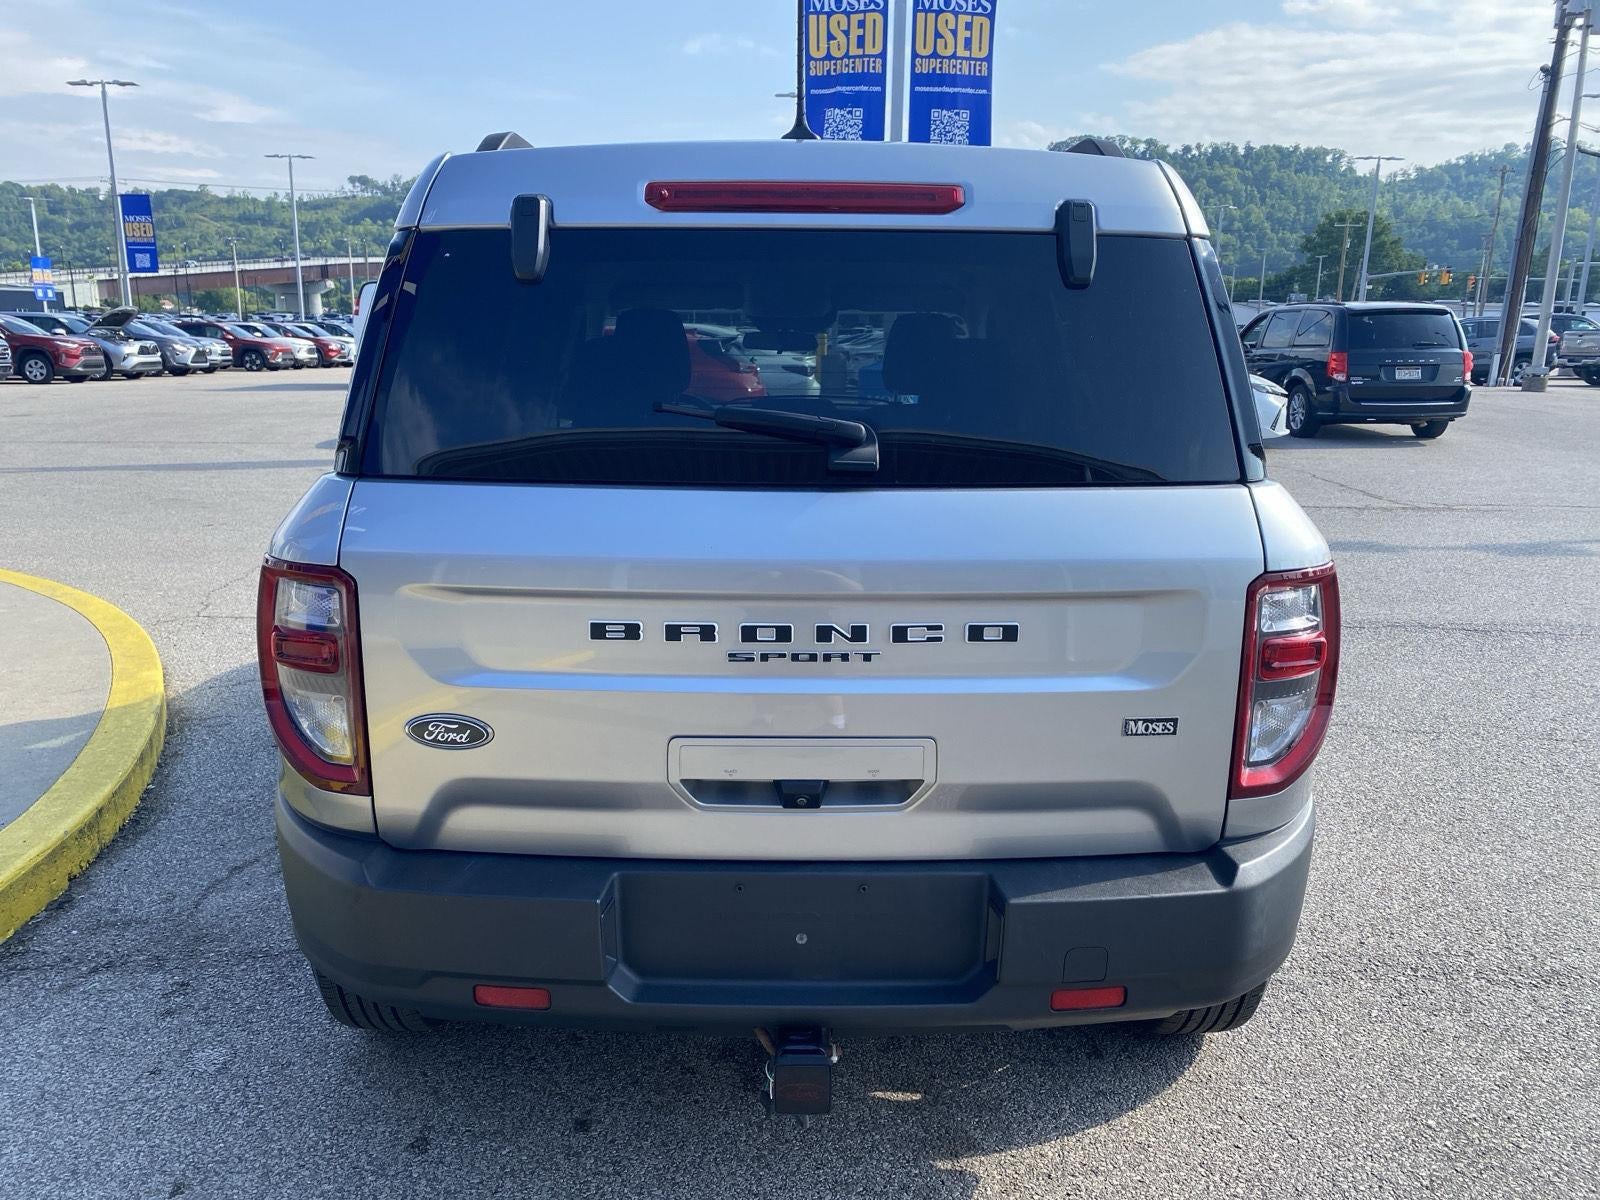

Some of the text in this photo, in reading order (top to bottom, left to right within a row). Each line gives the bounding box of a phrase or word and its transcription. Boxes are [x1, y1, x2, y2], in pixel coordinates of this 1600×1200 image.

[809, 0, 885, 12] MOSES
[808, 12, 884, 59] USED
[915, 12, 991, 58] USED
[809, 58, 882, 76] SUPERCENTER
[914, 57, 988, 76] SUPERCENTER
[124, 215, 151, 223] MOSES
[125, 223, 153, 237] USED
[588, 620, 1020, 644] BRONCO
[727, 651, 882, 663] SPORT
[424, 722, 470, 742] Ford
[1127, 720, 1174, 735] MOSES
